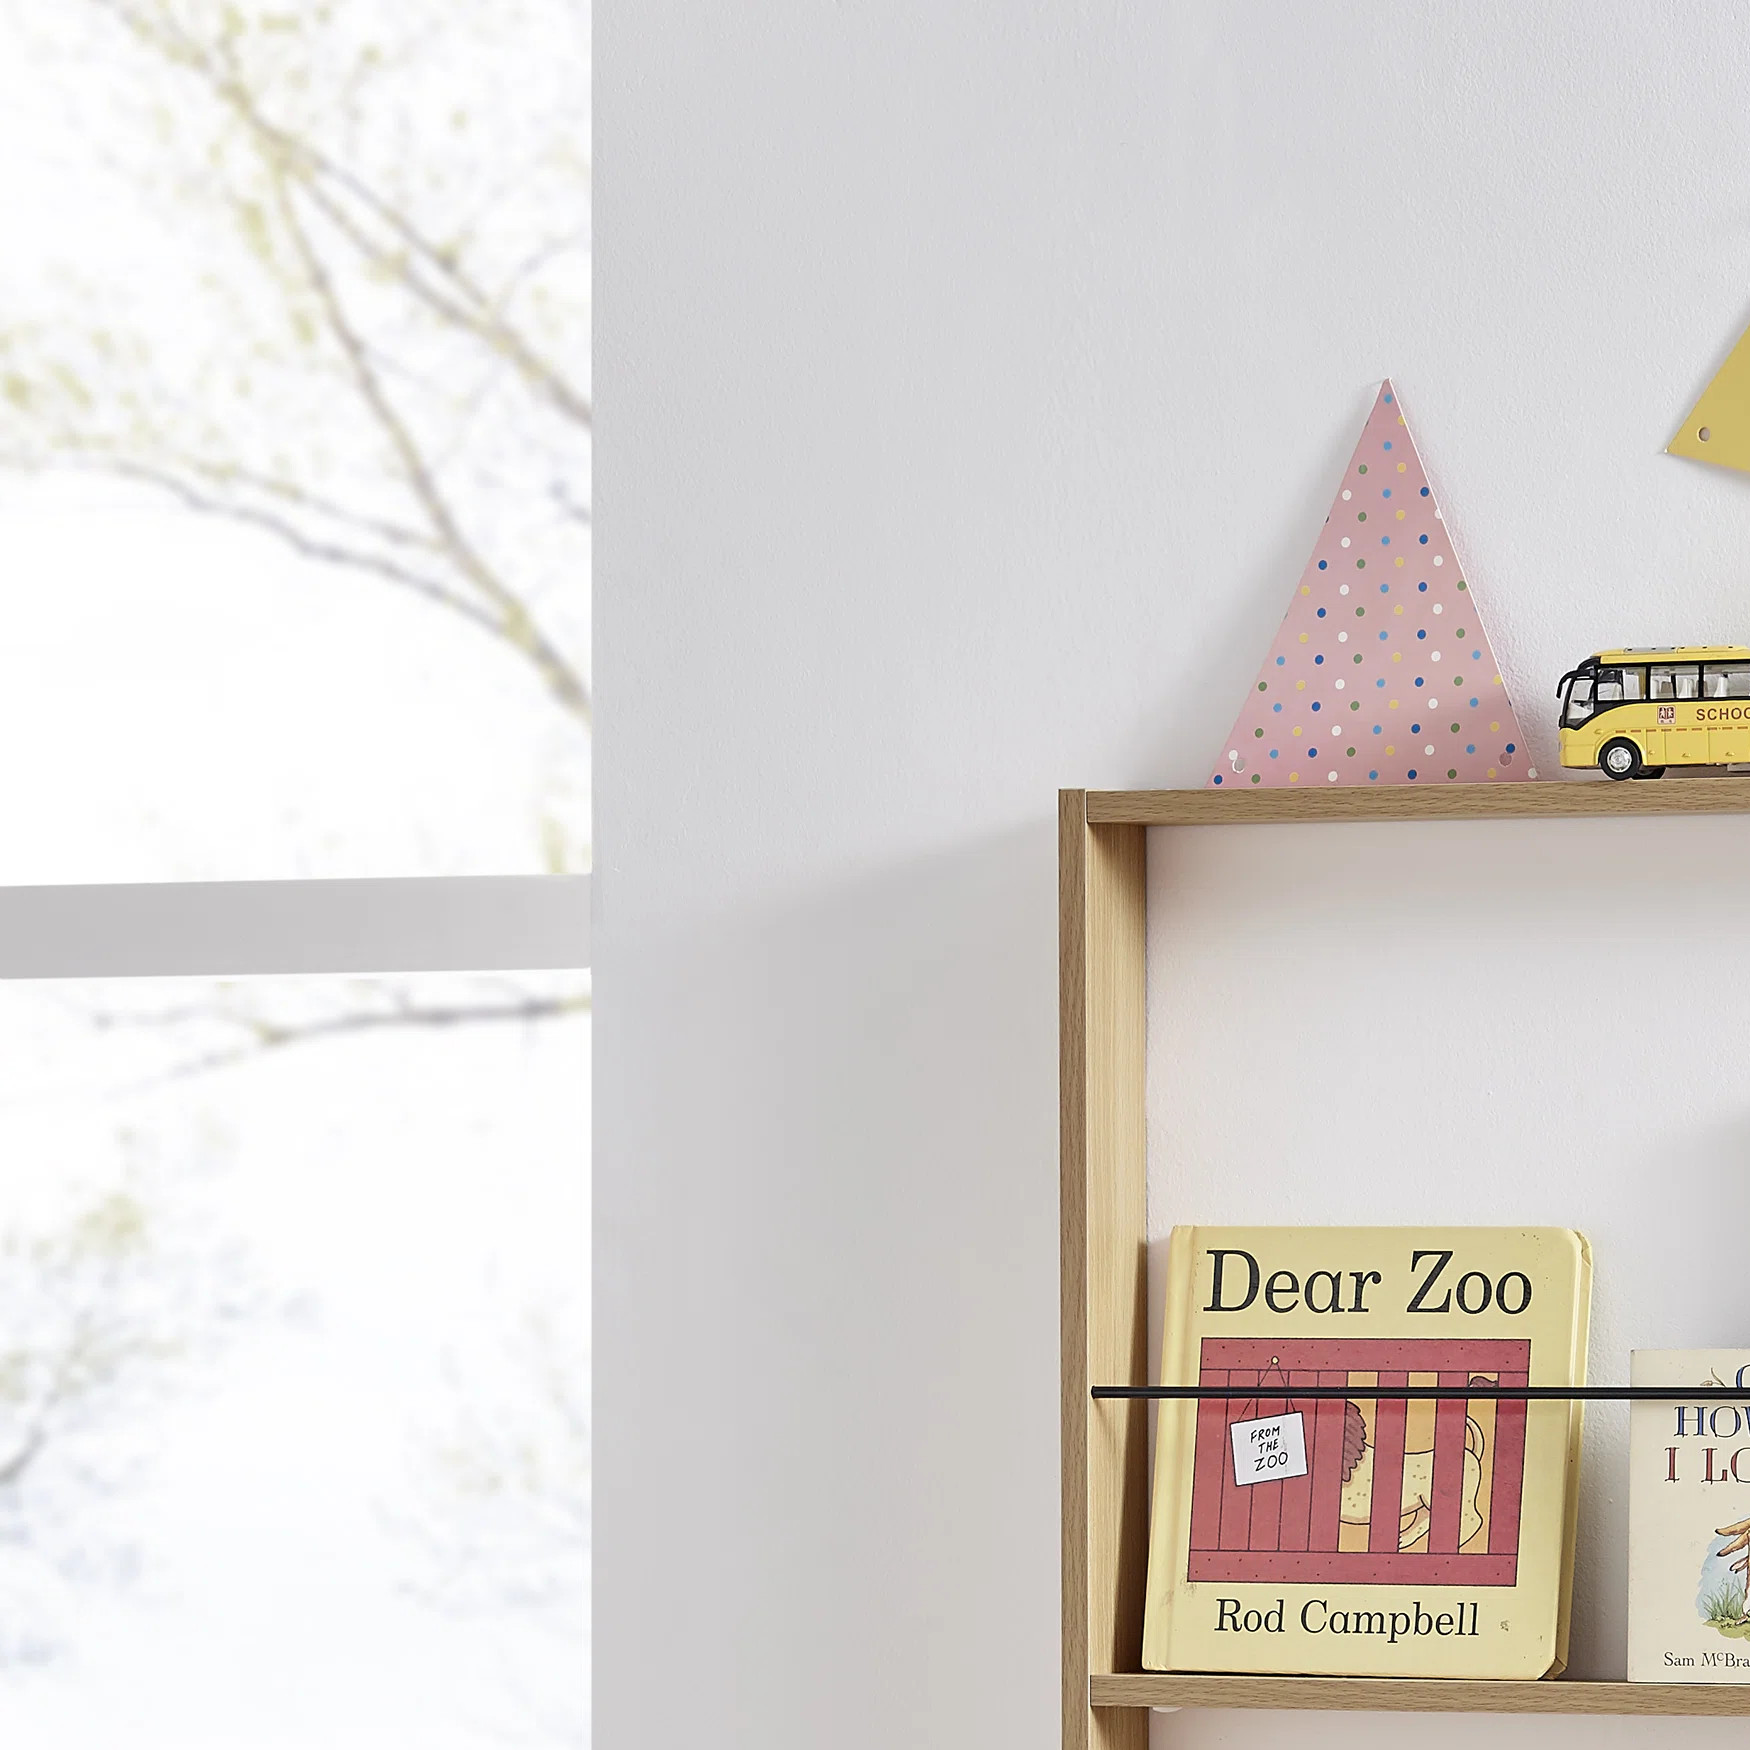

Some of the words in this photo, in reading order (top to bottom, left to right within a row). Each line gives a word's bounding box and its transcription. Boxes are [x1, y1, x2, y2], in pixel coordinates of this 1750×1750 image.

[1203, 1249, 1382, 1315] Dear
[1406, 1250, 1533, 1315] Zoo
[1250, 1425, 1280, 1443] FROM
[1258, 1438, 1279, 1453] THE
[1254, 1452, 1288, 1472] ZOO
[1664, 1447, 1680, 1483] I
[1213, 1598, 1286, 1633] Rod
[1300, 1600, 1480, 1644] Campbell
[1663, 1652, 1695, 1668] Sam
